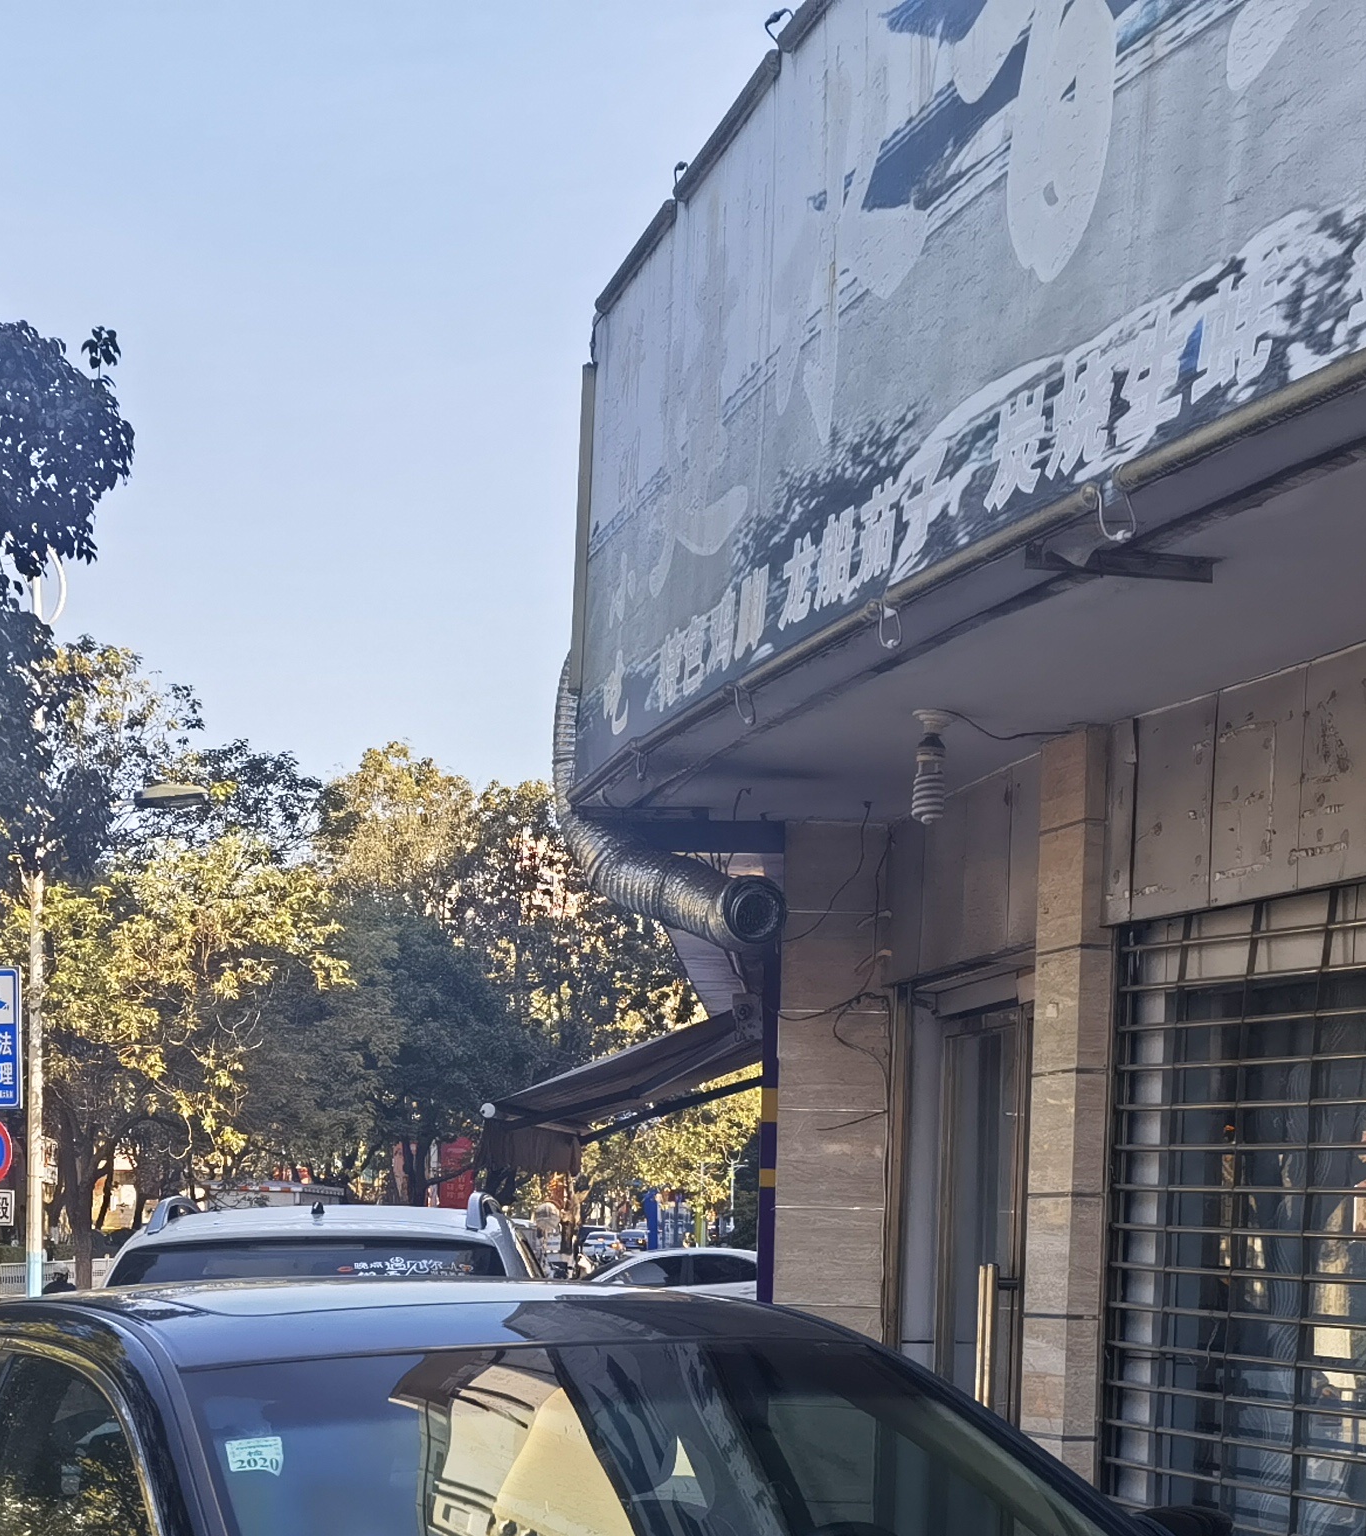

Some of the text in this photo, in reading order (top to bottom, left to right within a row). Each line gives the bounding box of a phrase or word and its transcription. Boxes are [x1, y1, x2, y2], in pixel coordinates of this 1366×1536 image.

[778, 440, 951, 632] 龙船茄子
[984, 262, 1280, 511] 炭烧生蚝
[235, 1457, 280, 1472] 2020
